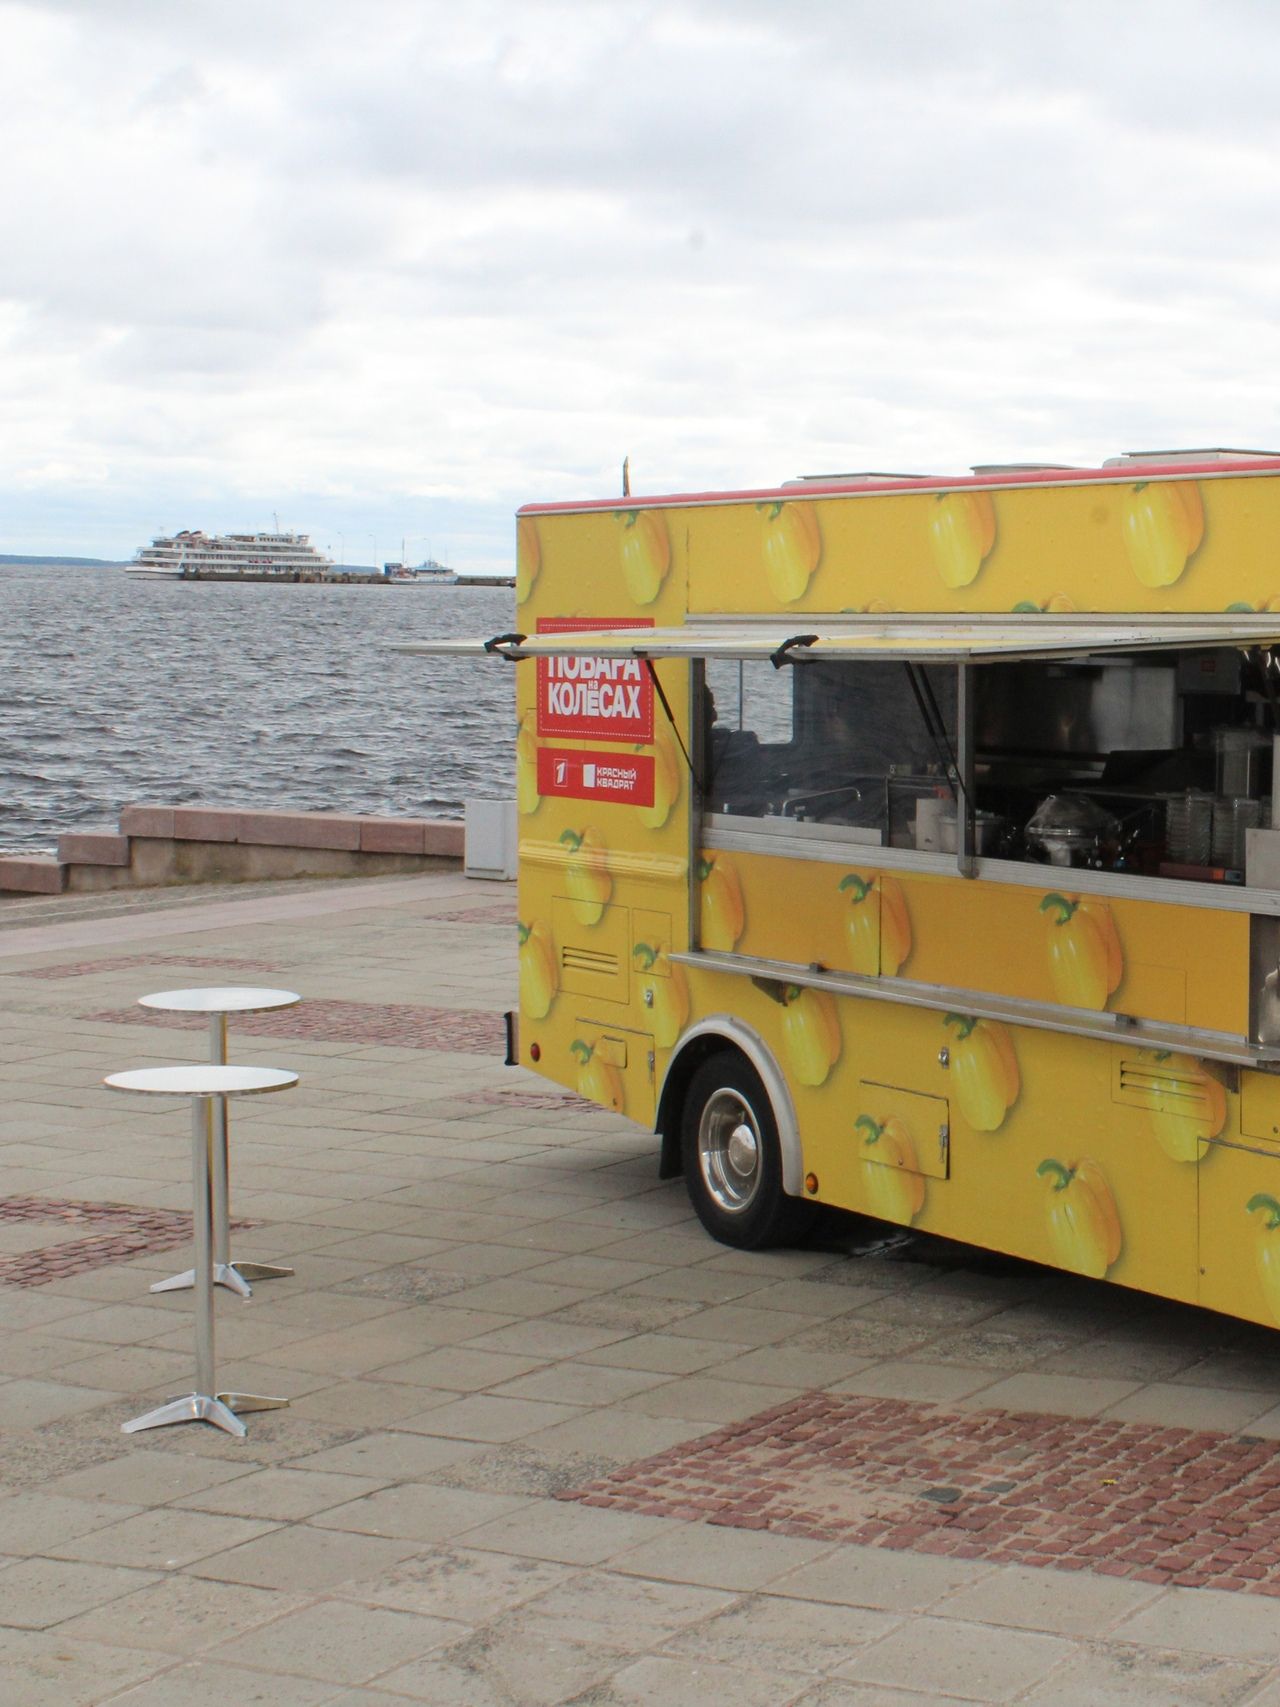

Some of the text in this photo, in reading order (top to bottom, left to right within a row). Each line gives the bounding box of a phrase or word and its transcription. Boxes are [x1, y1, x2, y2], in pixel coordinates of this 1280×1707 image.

[547, 656, 641, 681] ПОВАРА
[548, 682, 641, 719] КОЛЕСАХ
[556, 762, 565, 784] 1
[597, 767, 636, 780] КРАСНЫЙ
[597, 778, 634, 790] КВАДРАТ
